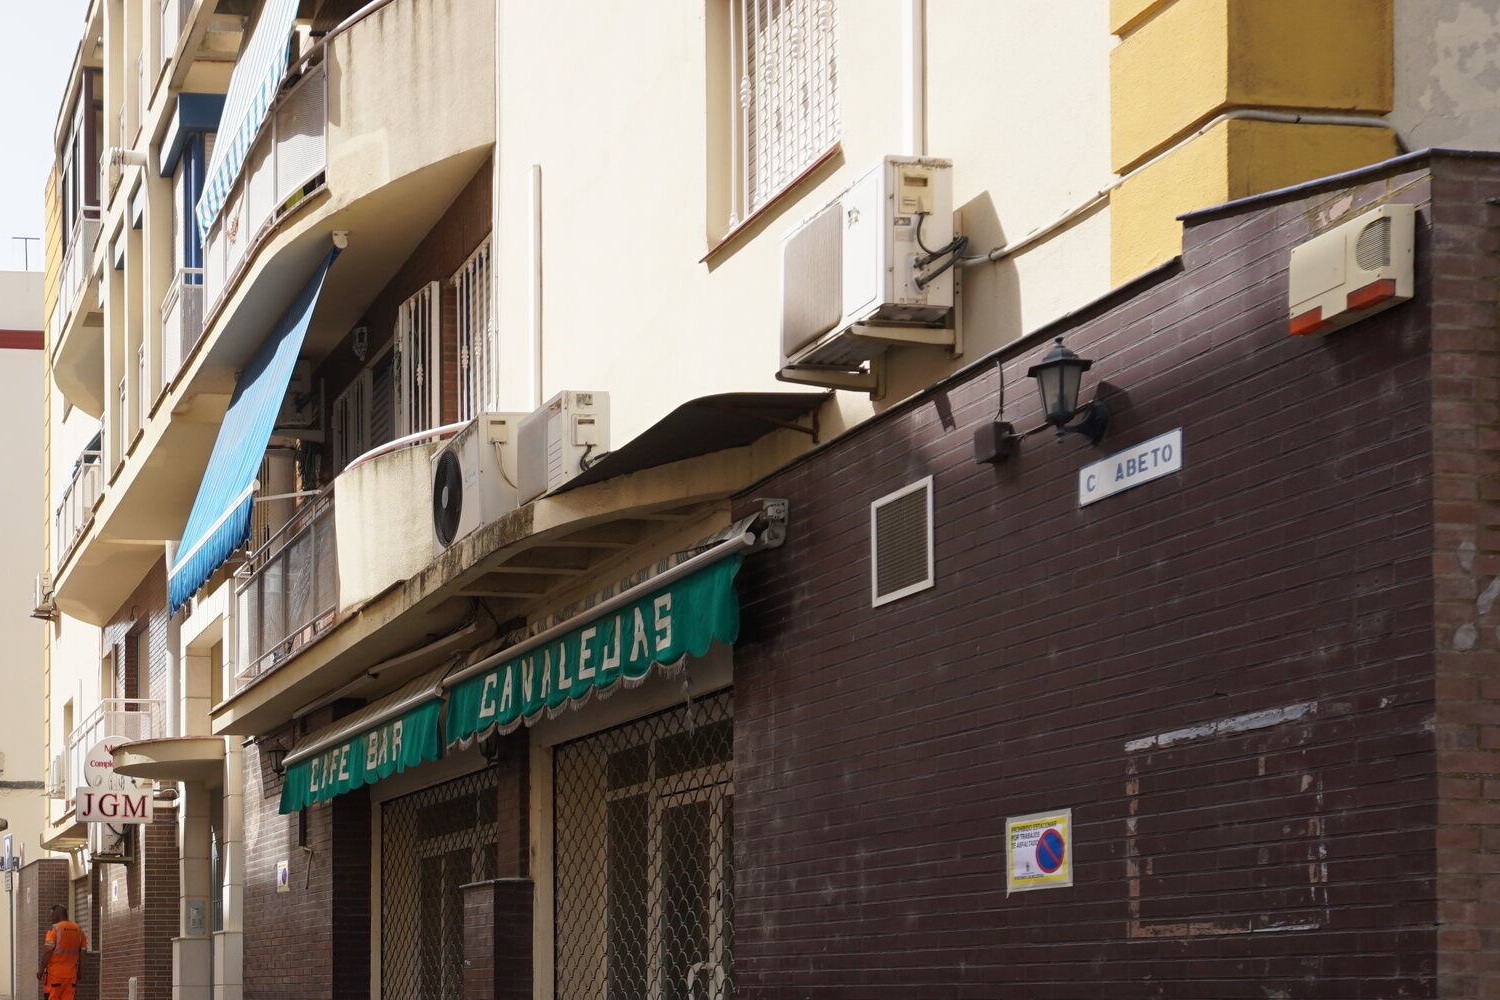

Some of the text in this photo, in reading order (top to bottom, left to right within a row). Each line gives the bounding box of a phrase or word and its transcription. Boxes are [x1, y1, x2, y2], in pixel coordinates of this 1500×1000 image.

[1086, 443, 1173, 493] C ABETO
[479, 592, 672, 718] CANALEJAS
[366, 719, 404, 771] BAR
[82, 793, 149, 819] JGM
